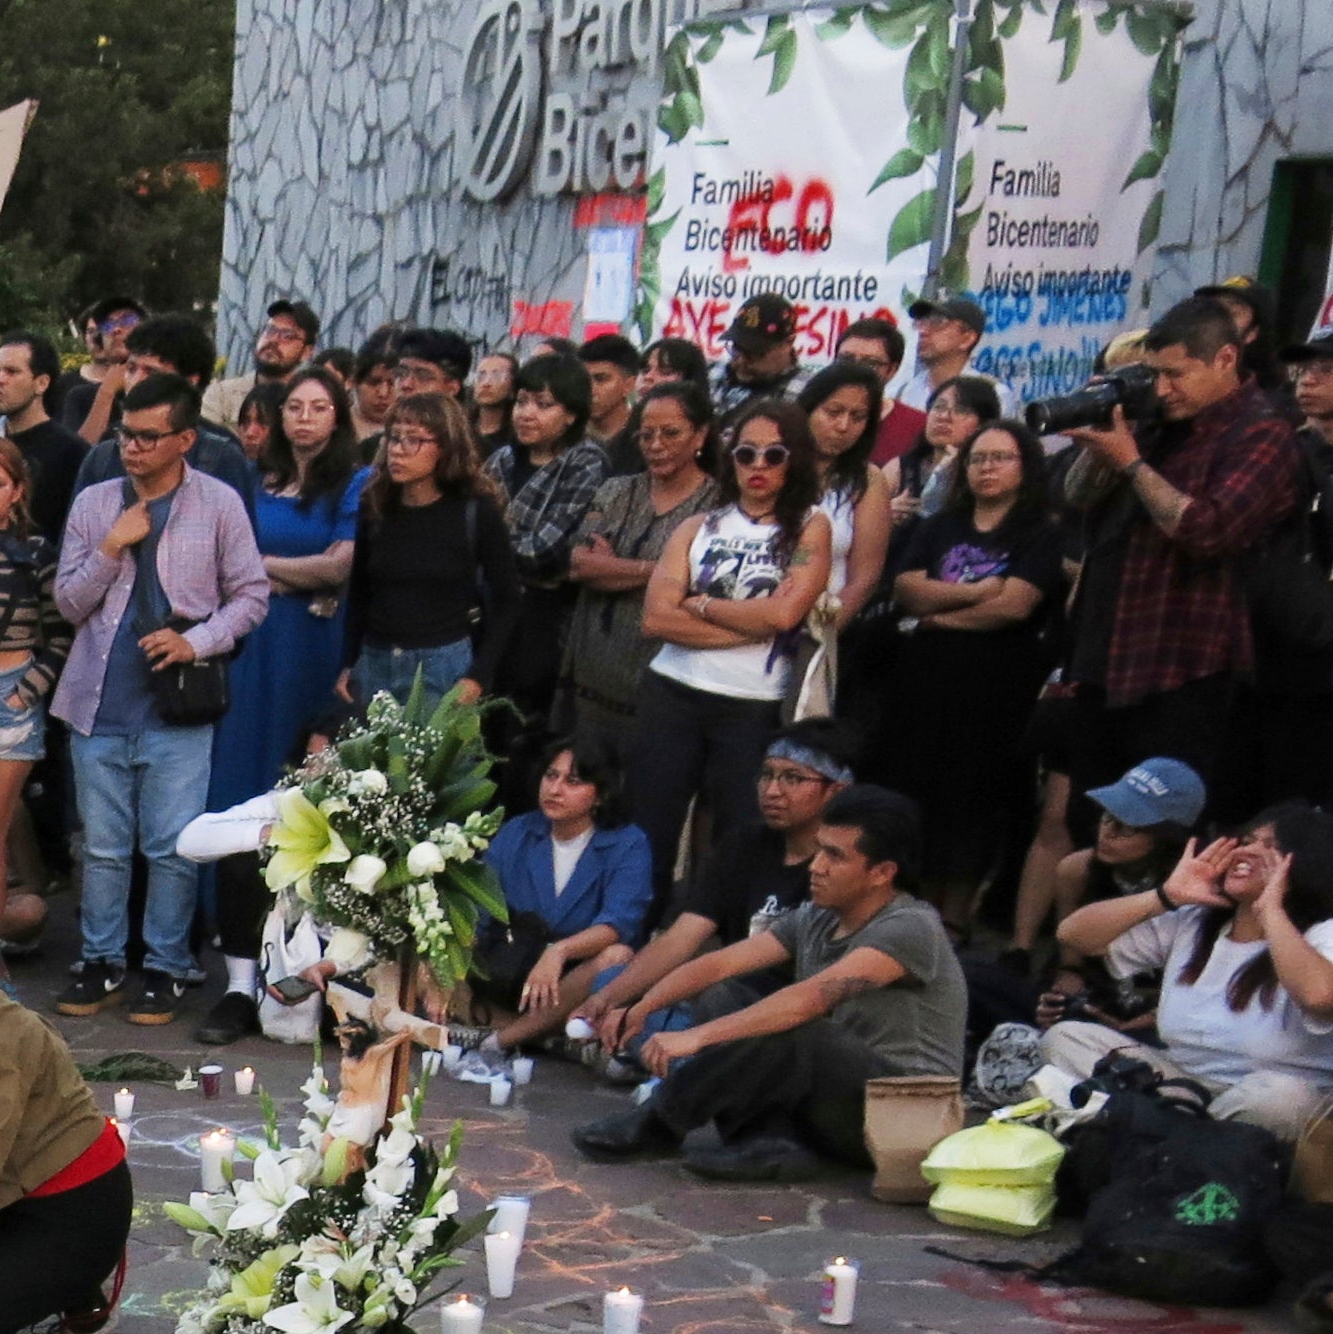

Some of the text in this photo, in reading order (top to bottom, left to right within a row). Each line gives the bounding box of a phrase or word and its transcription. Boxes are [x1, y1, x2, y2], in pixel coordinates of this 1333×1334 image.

[691, 171, 775, 206] Familia
[989, 159, 1061, 198] Familia
[685, 217, 833, 252] Bicentenario
[986, 212, 1100, 249] Bicentenario
[675, 266, 879, 301] Aviso importante
[983, 261, 1133, 297] Aviso importante
